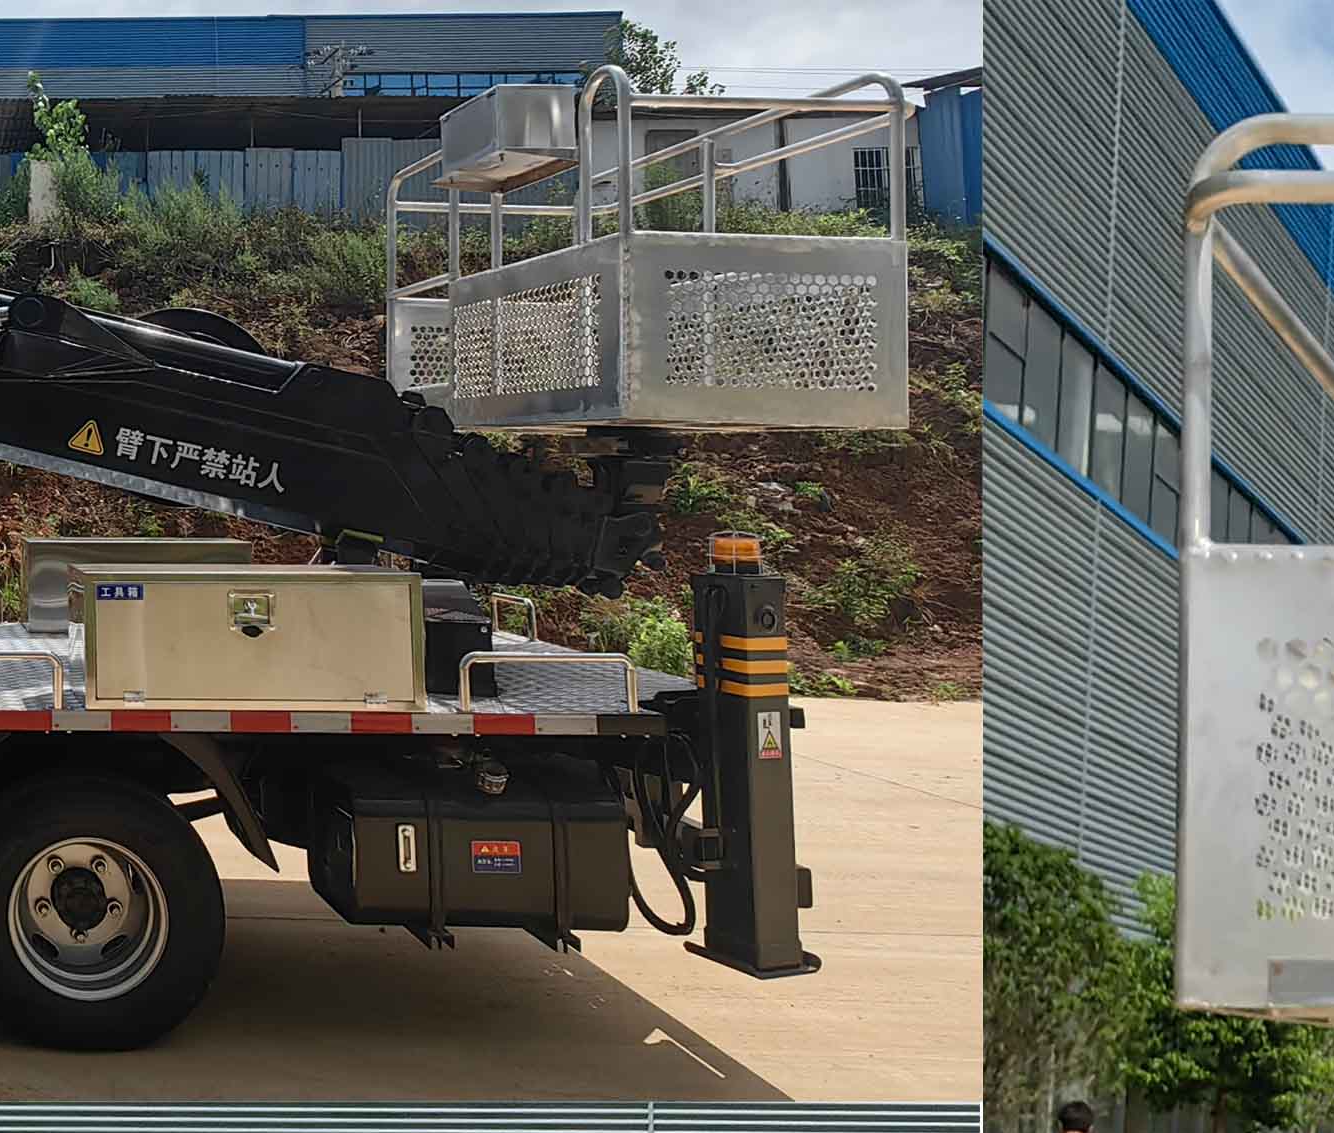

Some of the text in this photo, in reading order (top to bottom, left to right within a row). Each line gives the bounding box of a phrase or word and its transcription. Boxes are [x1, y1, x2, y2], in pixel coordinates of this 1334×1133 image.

[115, 426, 286, 494] 臂下严禁站人
[100, 586, 140, 598] 工具箱
